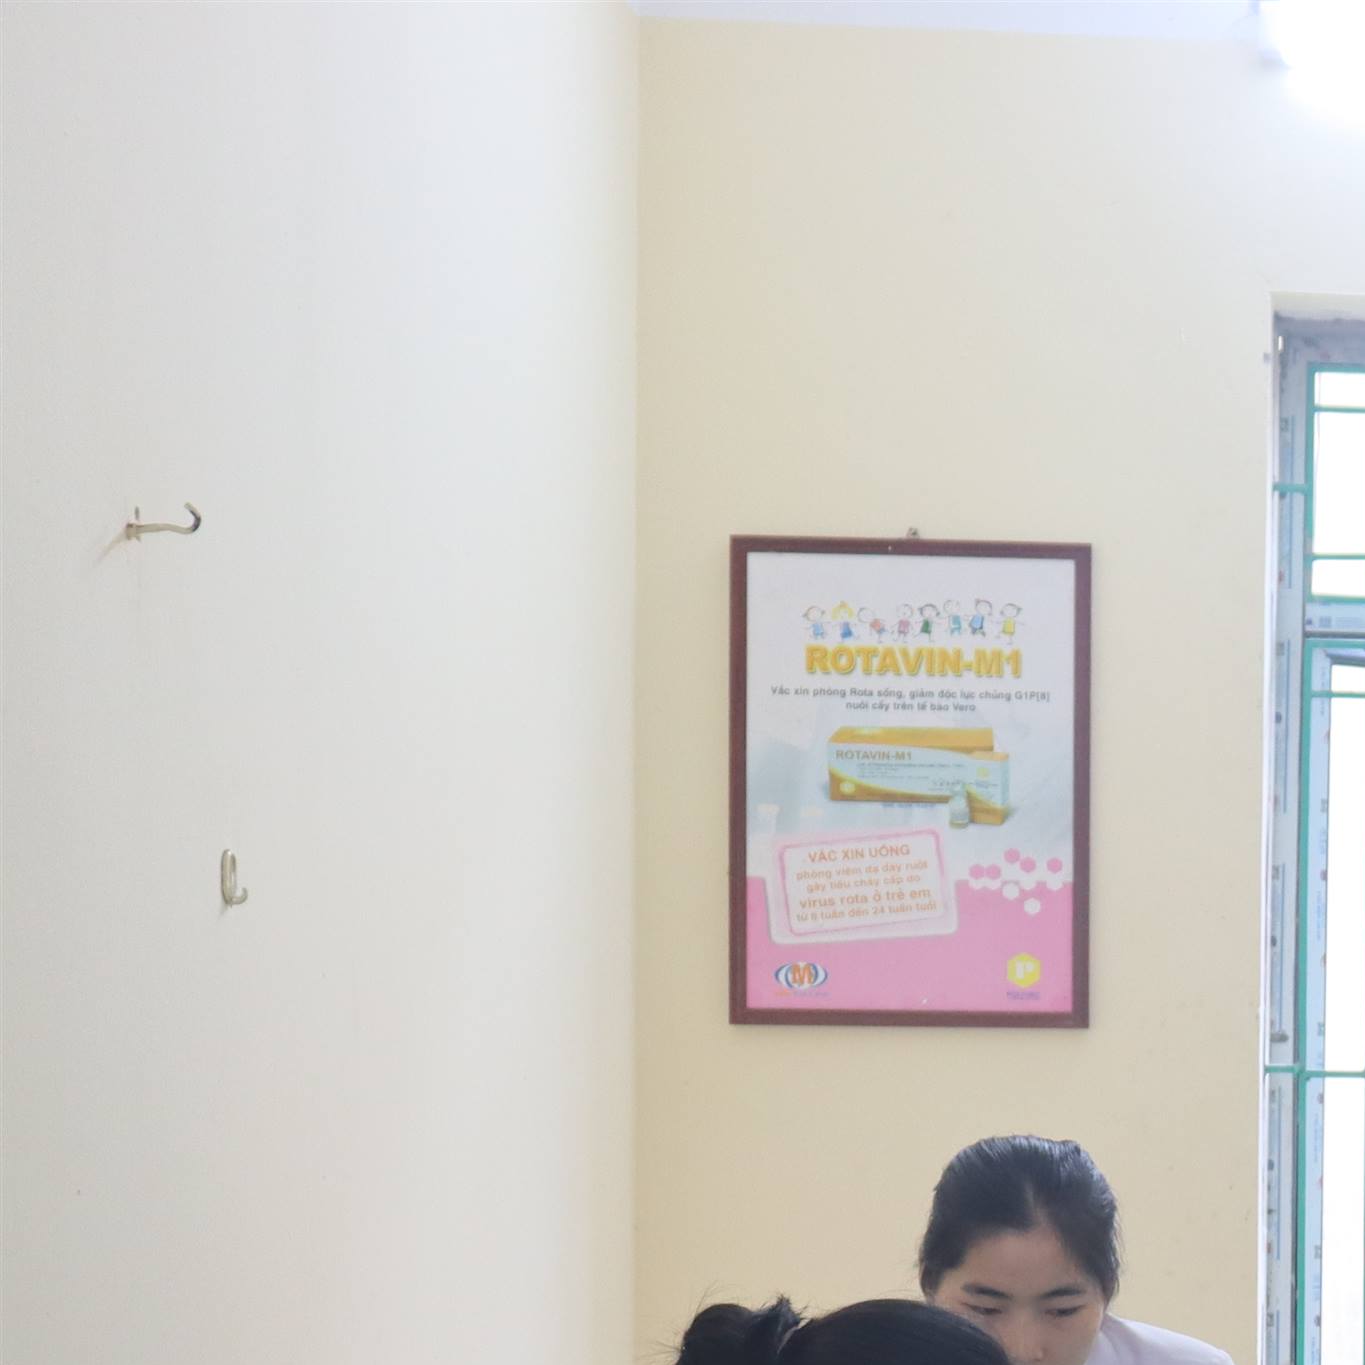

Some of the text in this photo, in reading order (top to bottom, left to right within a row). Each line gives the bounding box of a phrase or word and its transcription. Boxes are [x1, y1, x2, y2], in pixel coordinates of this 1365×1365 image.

[805, 645, 1022, 679] ROTAVIN-M1
[794, 686, 809, 696] xin
[850, 688, 873, 697] Rota
[953, 702, 976, 712] Vero
[836, 750, 912, 761] ROTAVIN-M1
[842, 848, 864, 861] XIN
[800, 897, 835, 909] virus
[840, 894, 868, 905] rota
[910, 888, 931, 898] em
